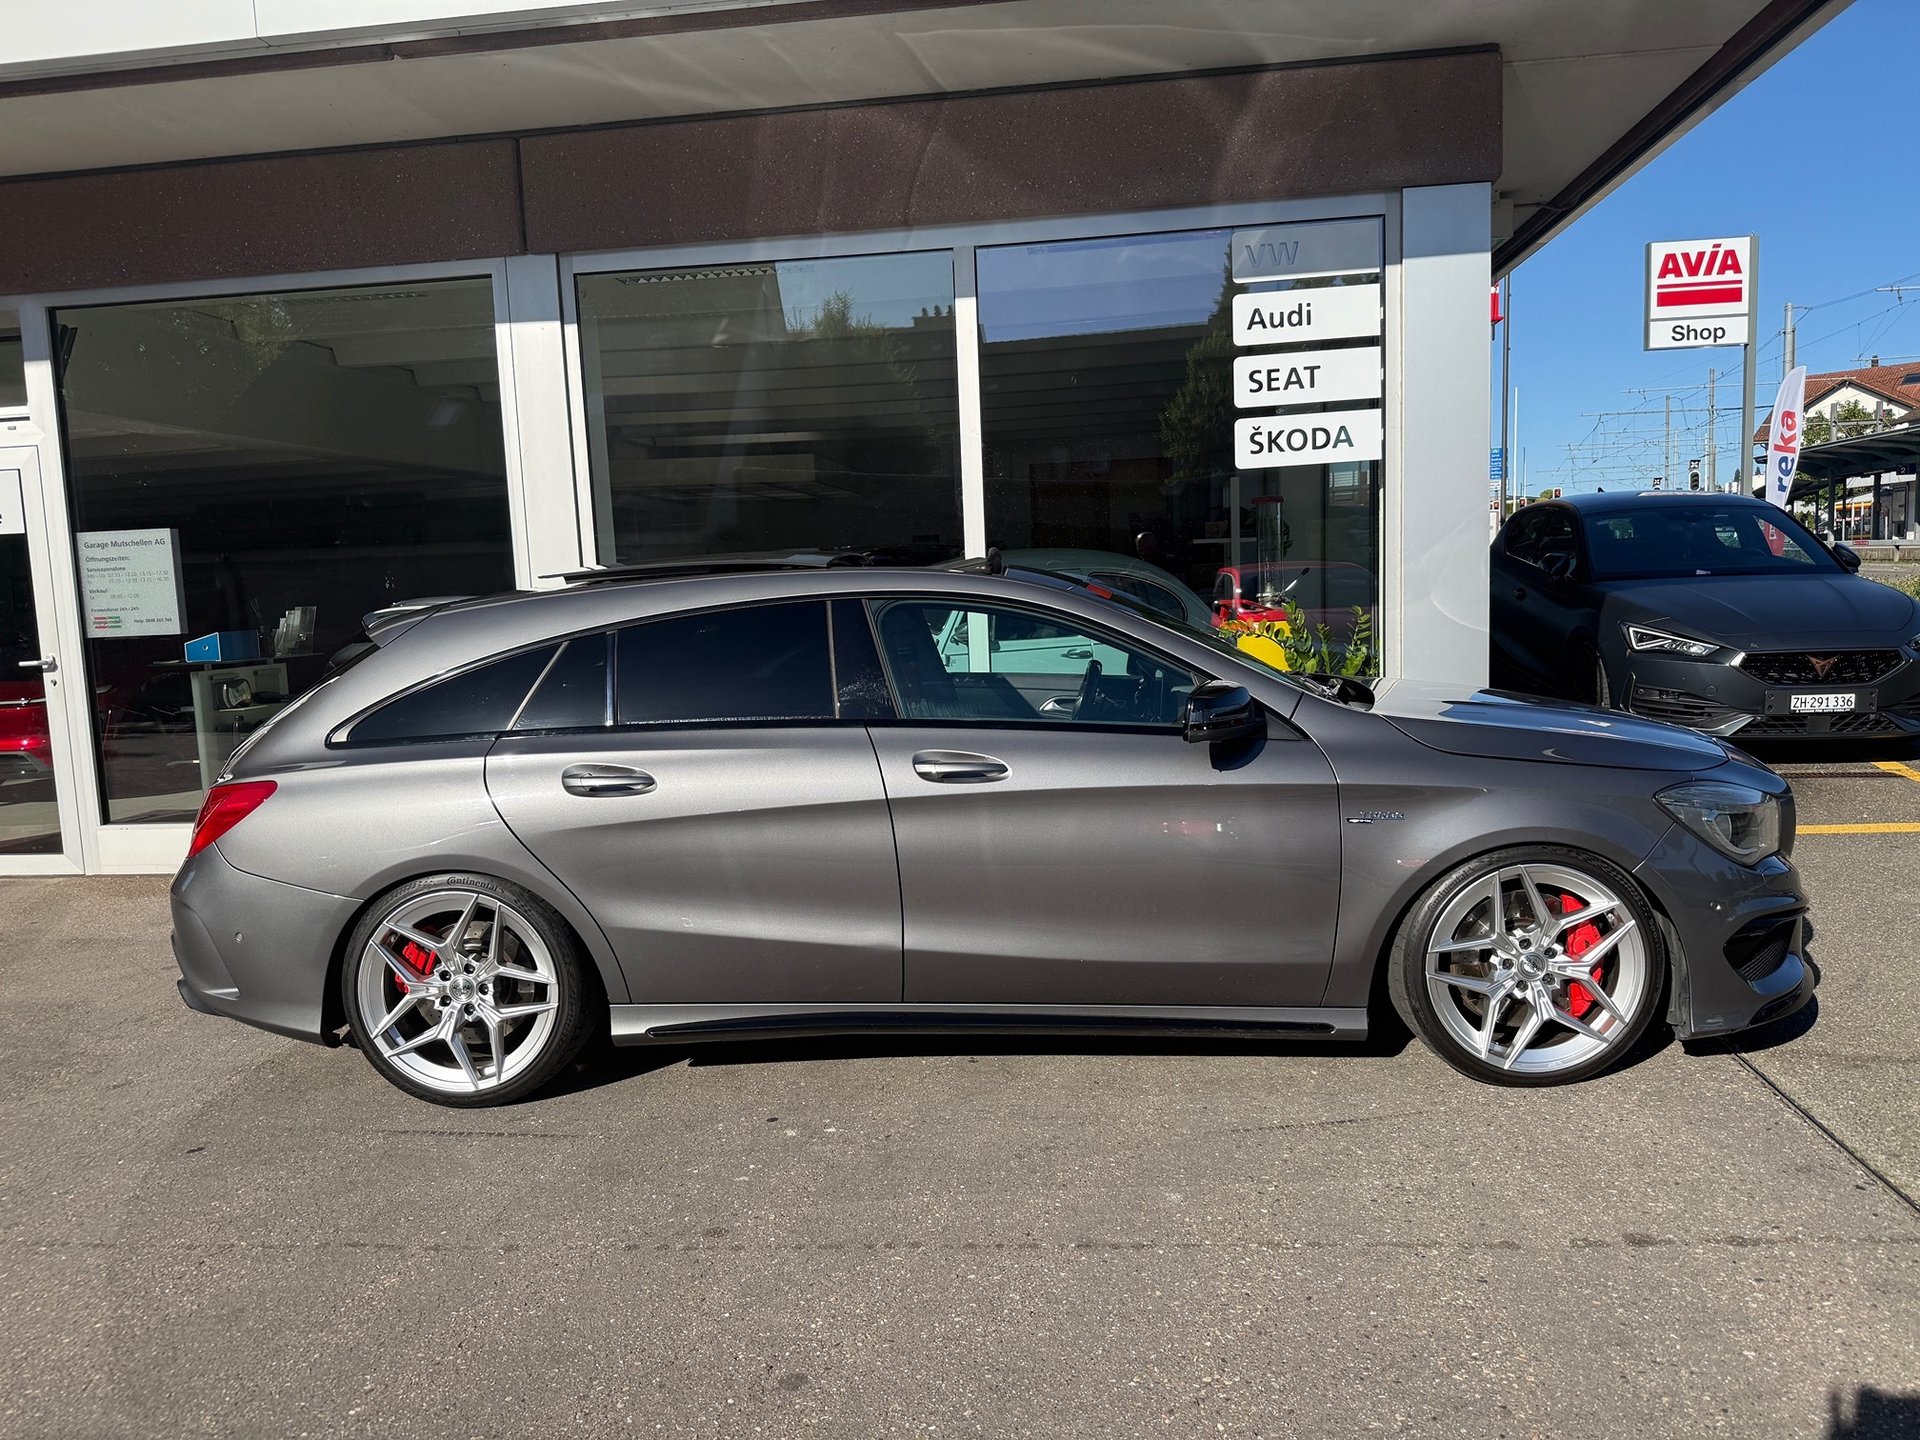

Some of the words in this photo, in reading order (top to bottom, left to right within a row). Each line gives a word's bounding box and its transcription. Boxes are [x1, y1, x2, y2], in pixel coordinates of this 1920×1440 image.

[1245, 240, 1299, 268] VW
[1247, 302, 1312, 330] Audi
[1671, 324, 1726, 343] Shop
[1248, 365, 1321, 394] SEAT
[1249, 425, 1354, 455] ŠKODA
[1774, 410, 1797, 493] reka
[84, 541, 110, 549] Garage
[111, 539, 153, 548] Mutschellen
[154, 538, 166, 546] AG
[446, 876, 498, 892] Continental
[1428, 870, 1469, 911] Continental
